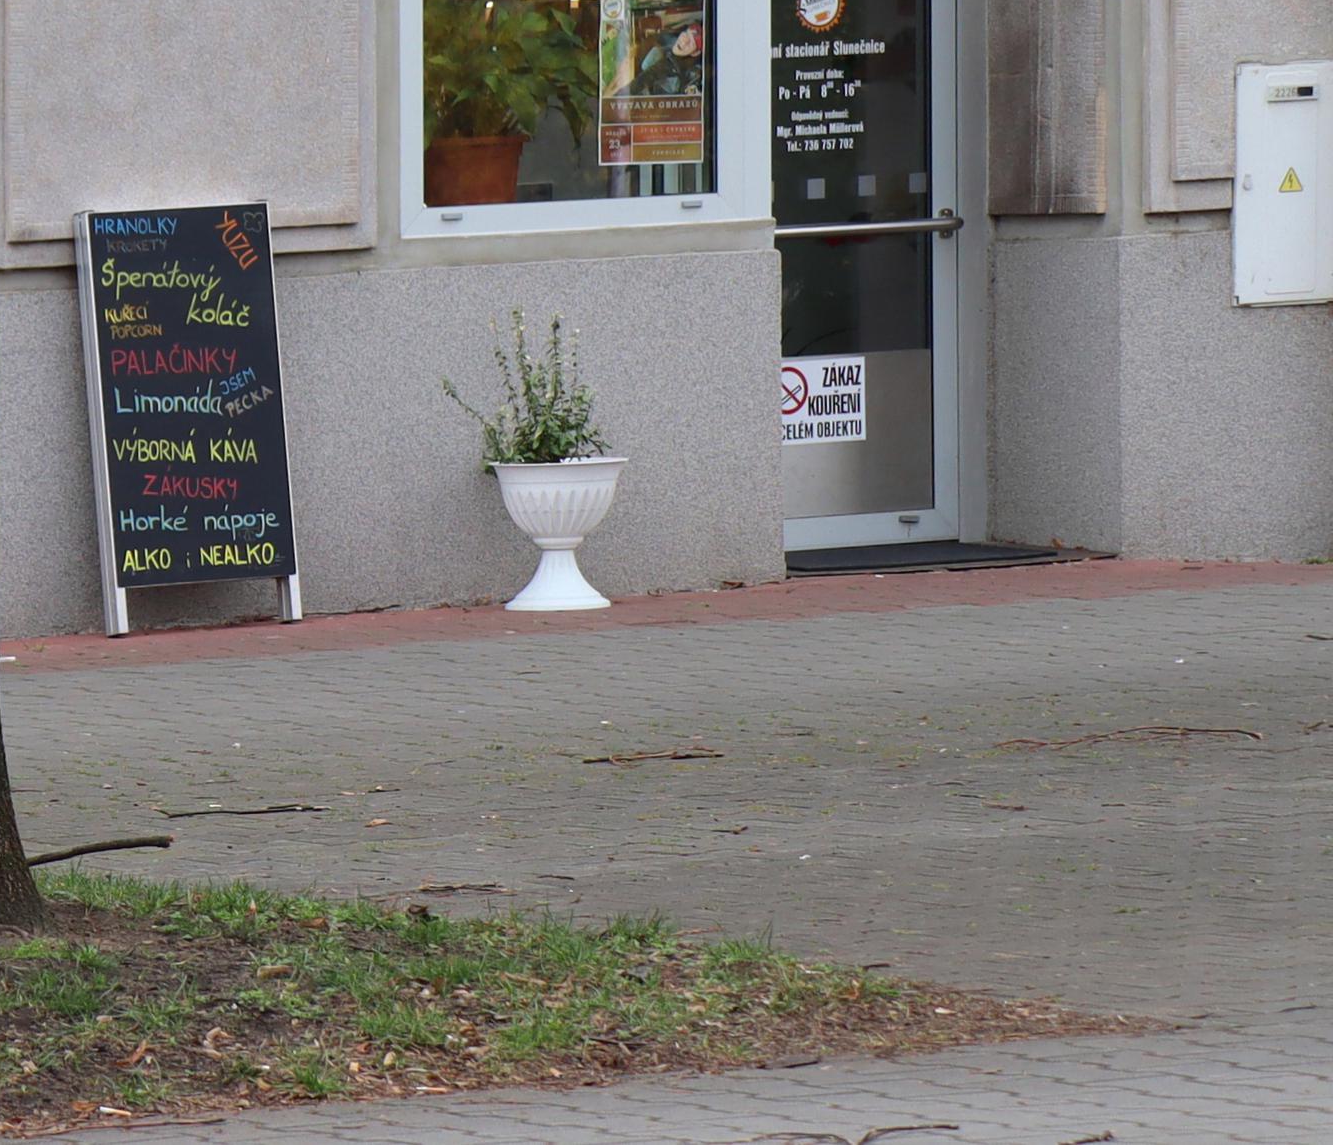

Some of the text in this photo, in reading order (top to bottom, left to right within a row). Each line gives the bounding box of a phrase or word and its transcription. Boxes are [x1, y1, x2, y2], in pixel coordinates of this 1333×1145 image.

[785, 41, 830, 58] stacionář
[833, 39, 885, 56] Slunečnice
[778, 86, 791, 101] Po
[799, 85, 811, 100] Pá
[821, 138, 837, 150] 757
[839, 137, 854, 150] 702
[95, 217, 178, 235] HRANOLKY
[215, 210, 260, 271] YUZU
[106, 238, 168, 253] KROKETY
[101, 257, 221, 302] Špenátový
[186, 292, 251, 327] koláč
[110, 324, 164, 340] POPCORN
[111, 343, 238, 376] PALAČINKY
[219, 367, 257, 395] JSEM
[822, 362, 862, 388] ZÁKAZ
[114, 378, 223, 417] Limonáda
[224, 385, 274, 418] PECKA
[808, 388, 861, 417] KOUŘENÍ
[817, 420, 862, 438] OBJEKTU
[112, 427, 259, 465] VÝBORNÁ KÁVA
[142, 465, 238, 500] ZÁKUSKY
[119, 504, 280, 541] Horké nápoje
[123, 547, 172, 573] ALKO
[199, 541, 276, 567] NEALKO
